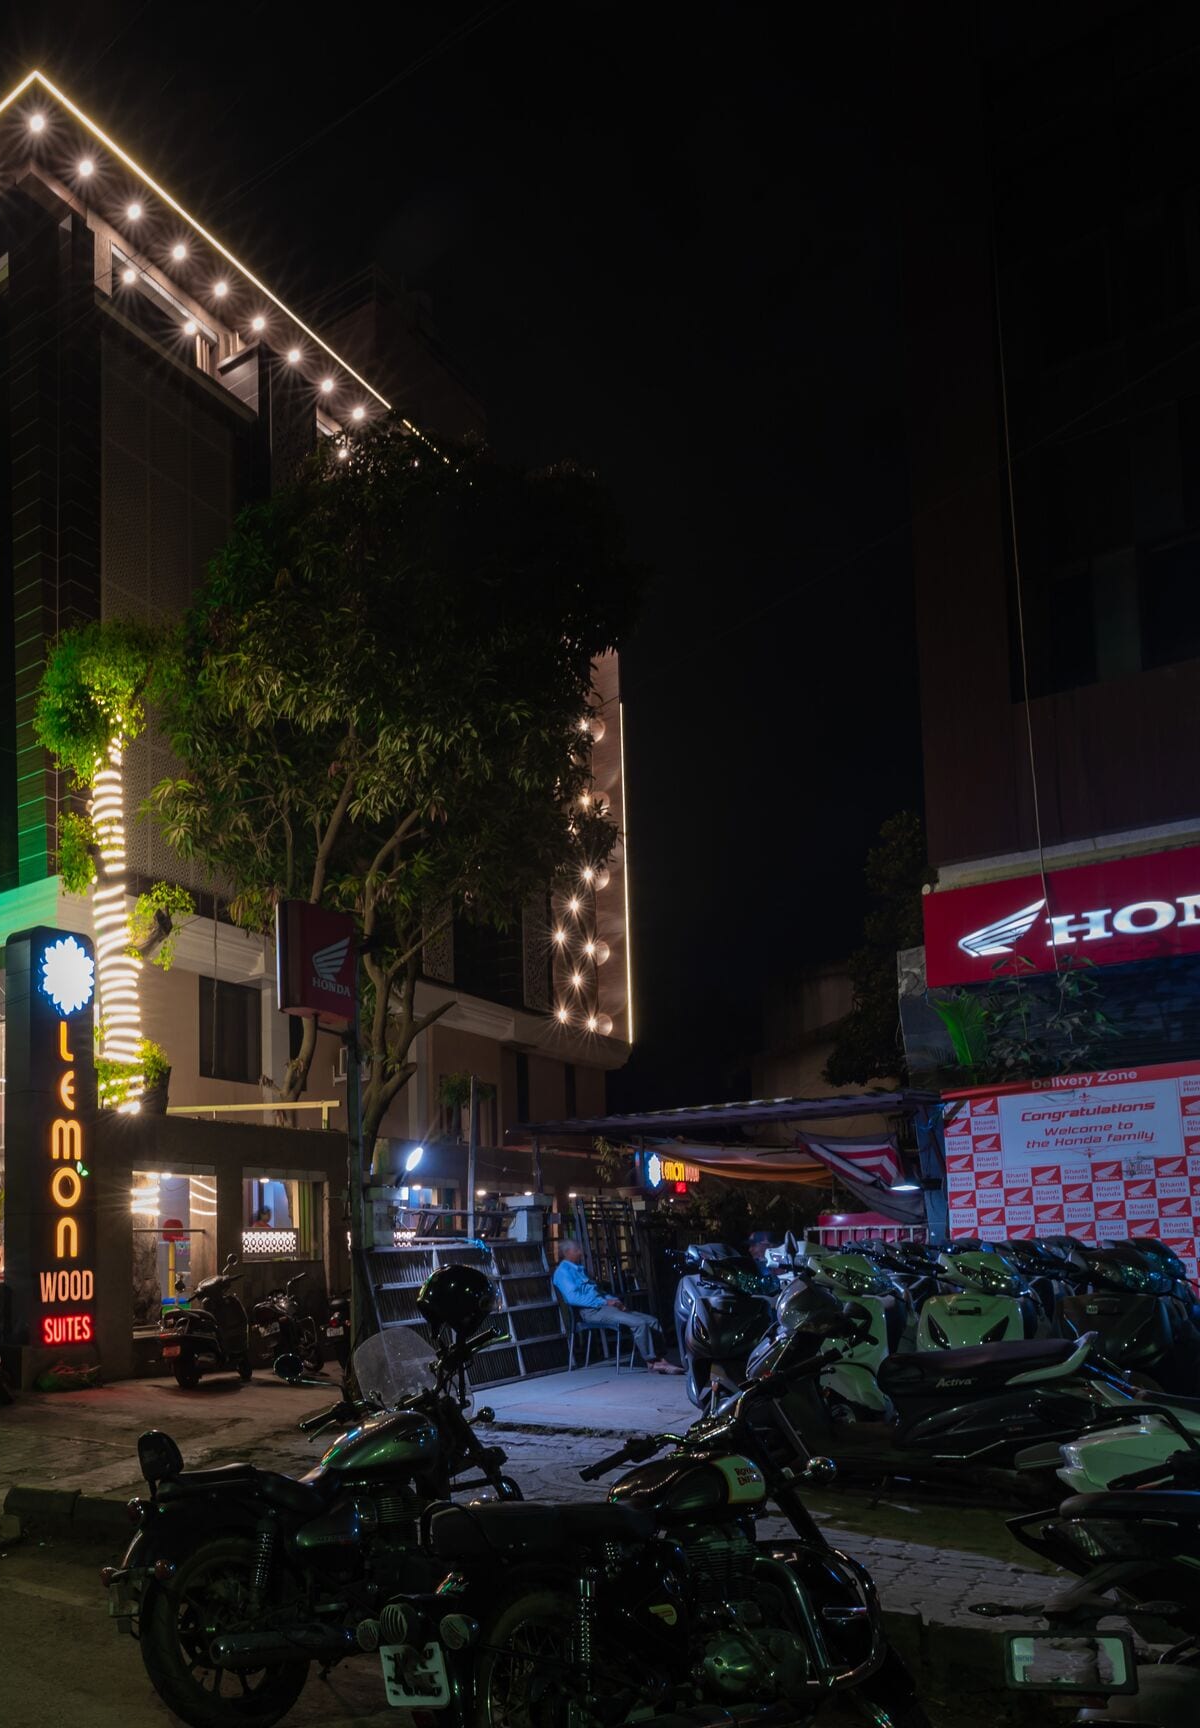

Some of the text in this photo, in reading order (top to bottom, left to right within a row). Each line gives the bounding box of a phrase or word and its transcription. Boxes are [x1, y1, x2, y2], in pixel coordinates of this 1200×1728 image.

[312, 977, 351, 997] HONDA
[1032, 1070, 1137, 1089] Delivery Zone
[1021, 1102, 1155, 1122] Congratulations
[1045, 1122, 1133, 1136] Welcome to
[1026, 1132, 1154, 1148] the Honda family
[40, 1270, 94, 1303] WOOD
[44, 1316, 91, 1344] SUITES
[936, 1378, 972, 1388] Activa
